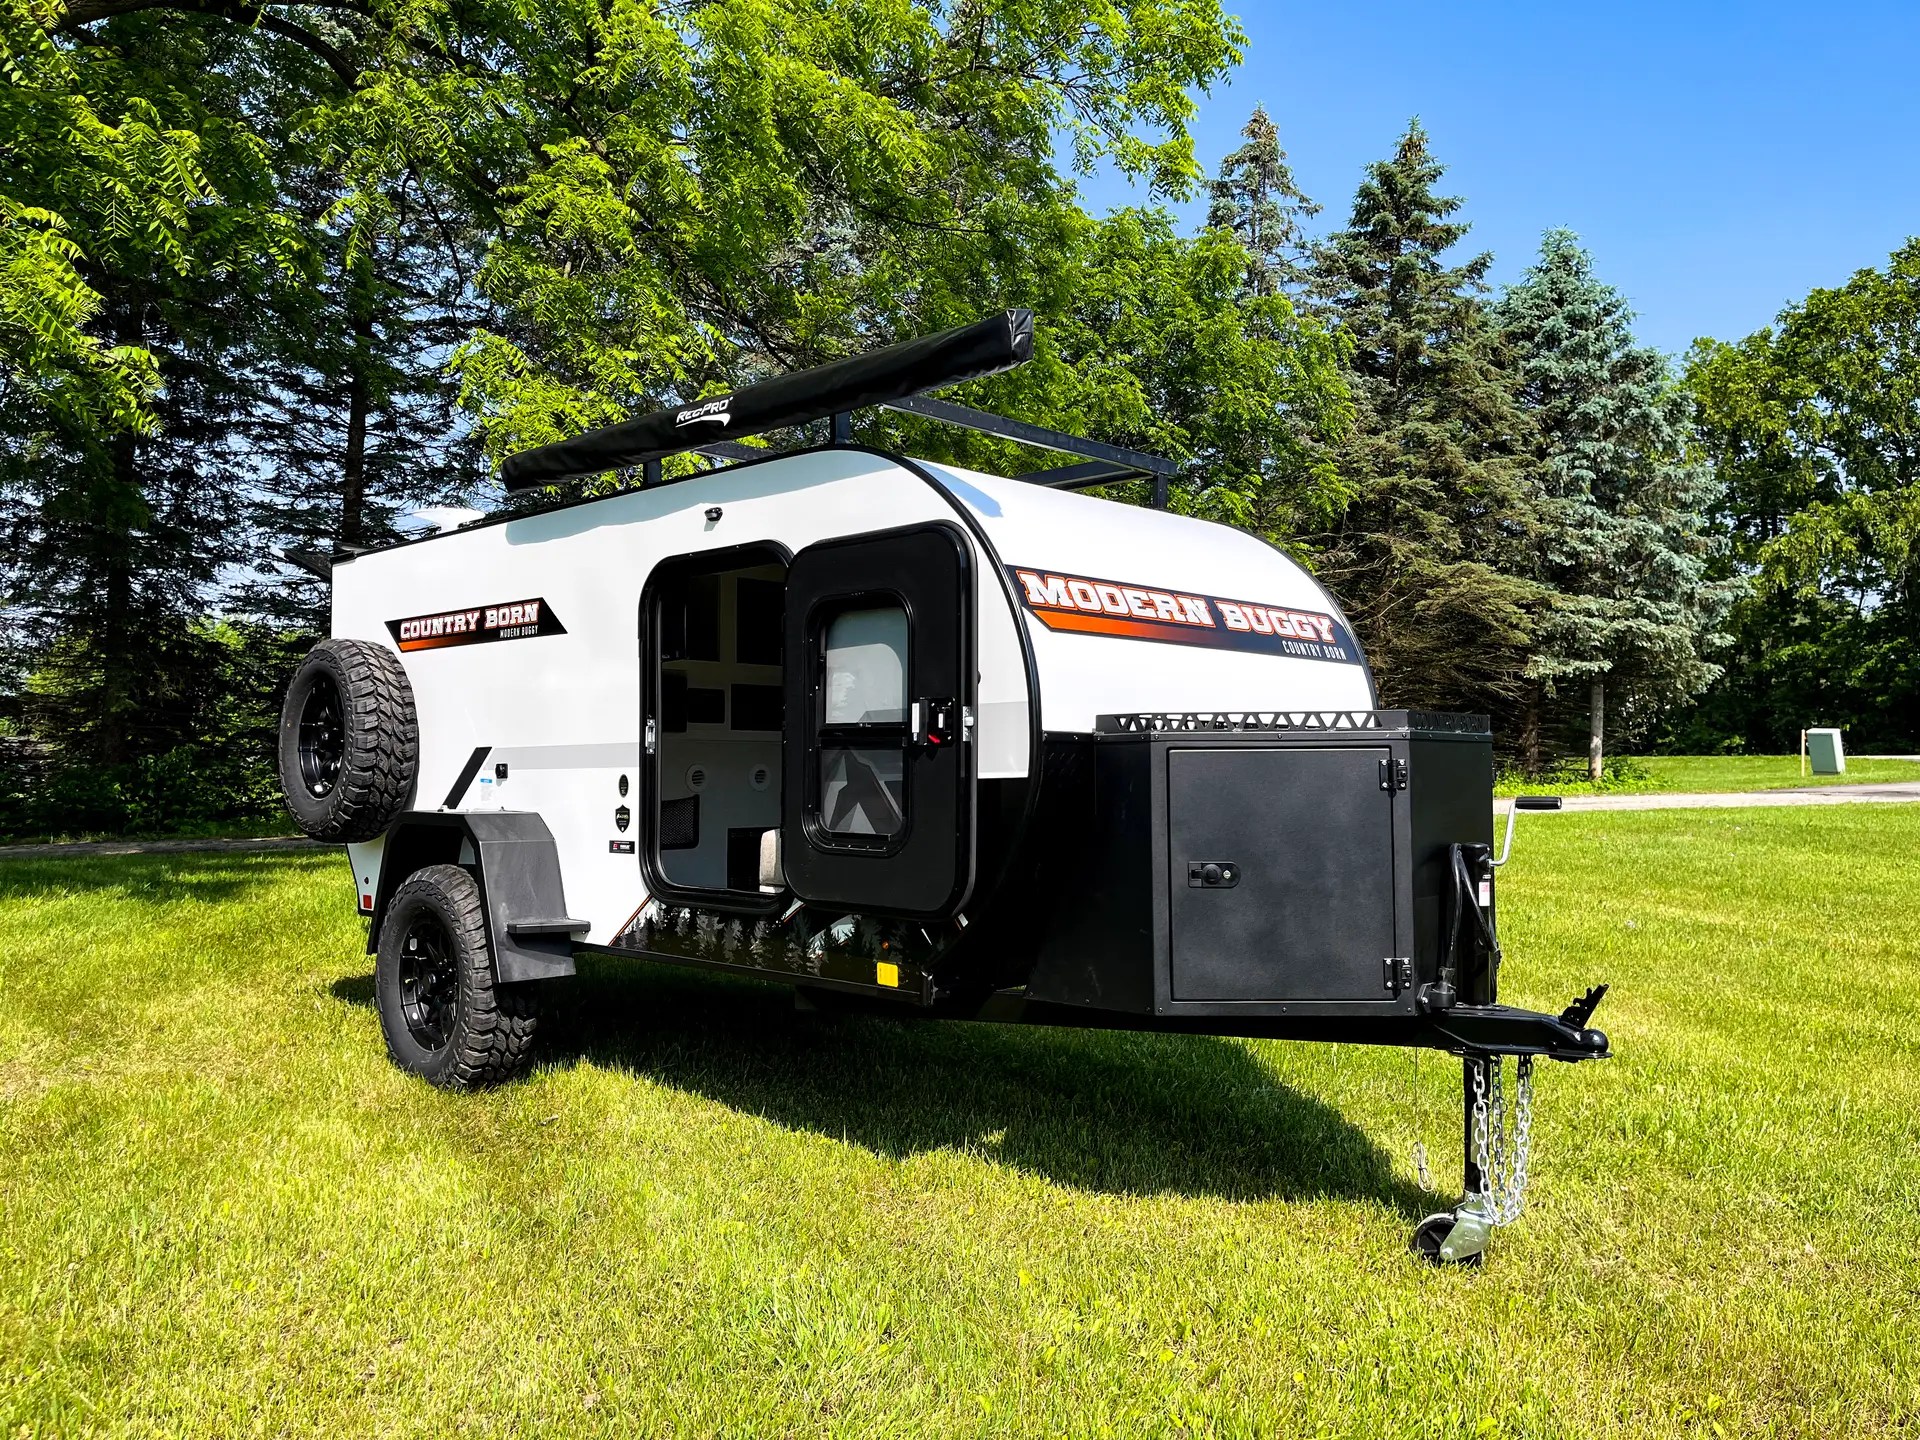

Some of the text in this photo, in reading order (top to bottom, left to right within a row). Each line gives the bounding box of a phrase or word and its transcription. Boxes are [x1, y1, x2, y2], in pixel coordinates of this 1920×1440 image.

[400, 602, 540, 640] COUNTRY BORN
[1016, 570, 1336, 643] MODERN BUGGY
[499, 625, 539, 638] MODERN BUGGY
[1281, 640, 1347, 660] COUNTRY BORN
